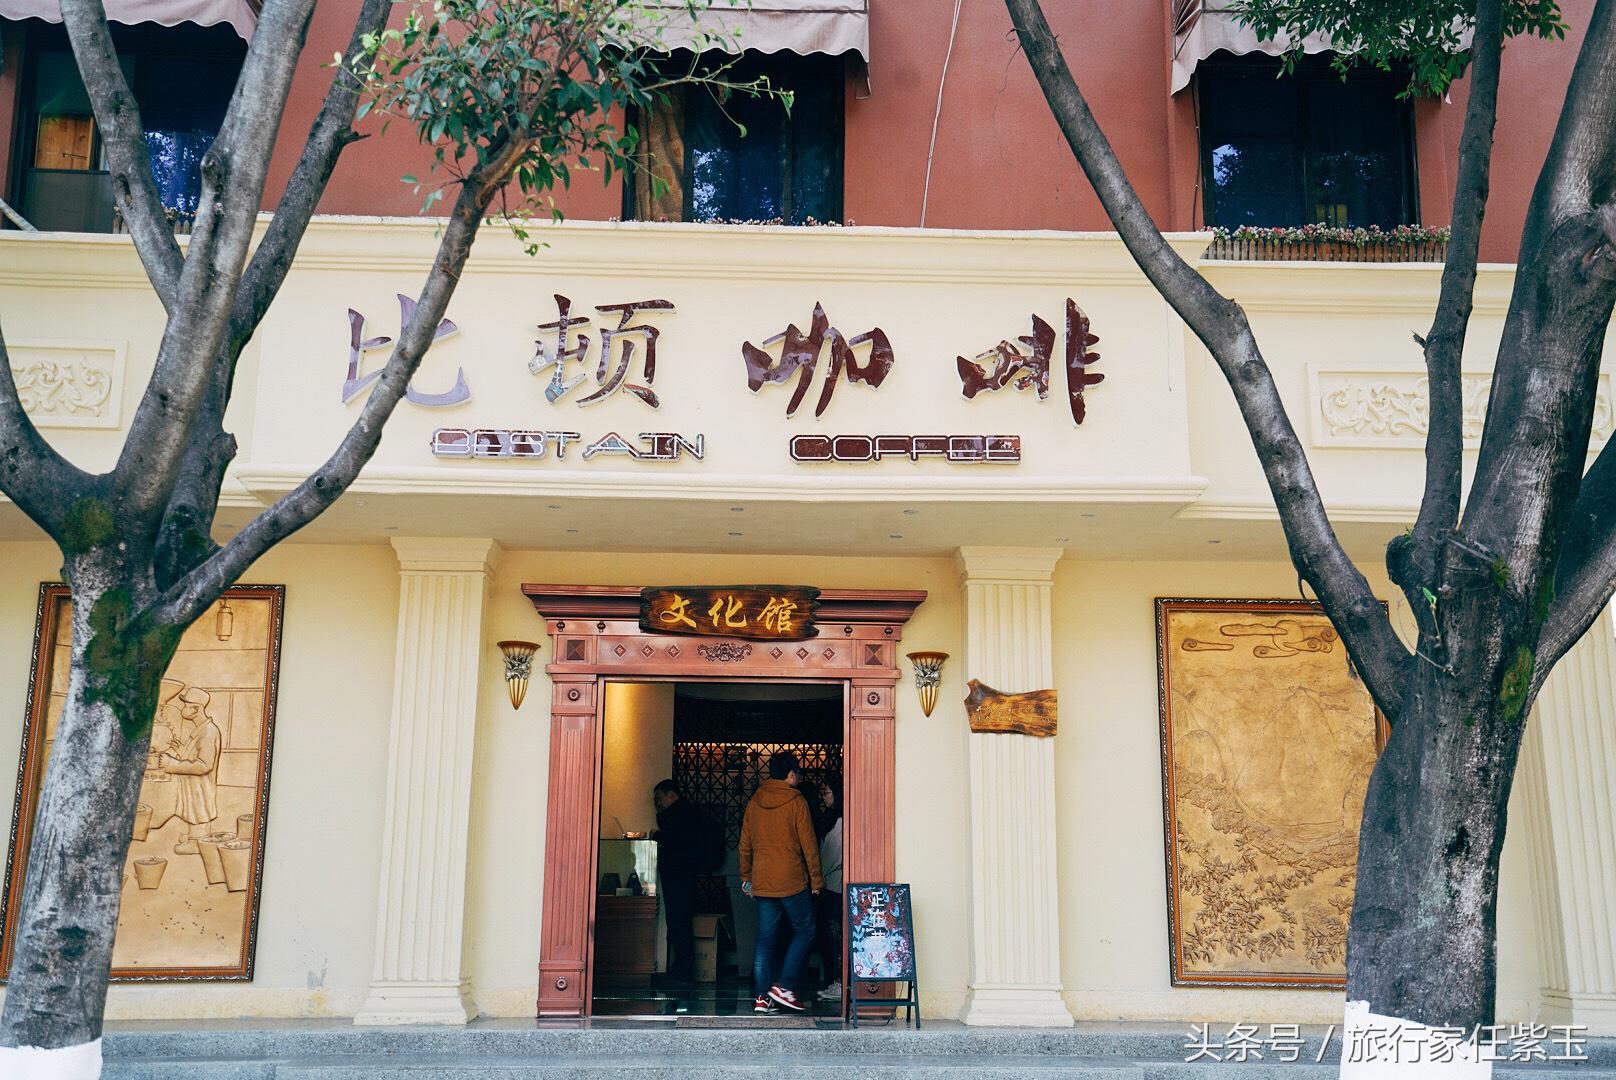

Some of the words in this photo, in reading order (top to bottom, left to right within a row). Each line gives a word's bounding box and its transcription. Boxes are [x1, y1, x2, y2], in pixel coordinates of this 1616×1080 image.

[342, 293, 1105, 427] 比顿咖啡
[430, 427, 705, 462] BESTAIN
[789, 434, 1021, 464] COFFEE
[659, 594, 798, 634] 文化馆
